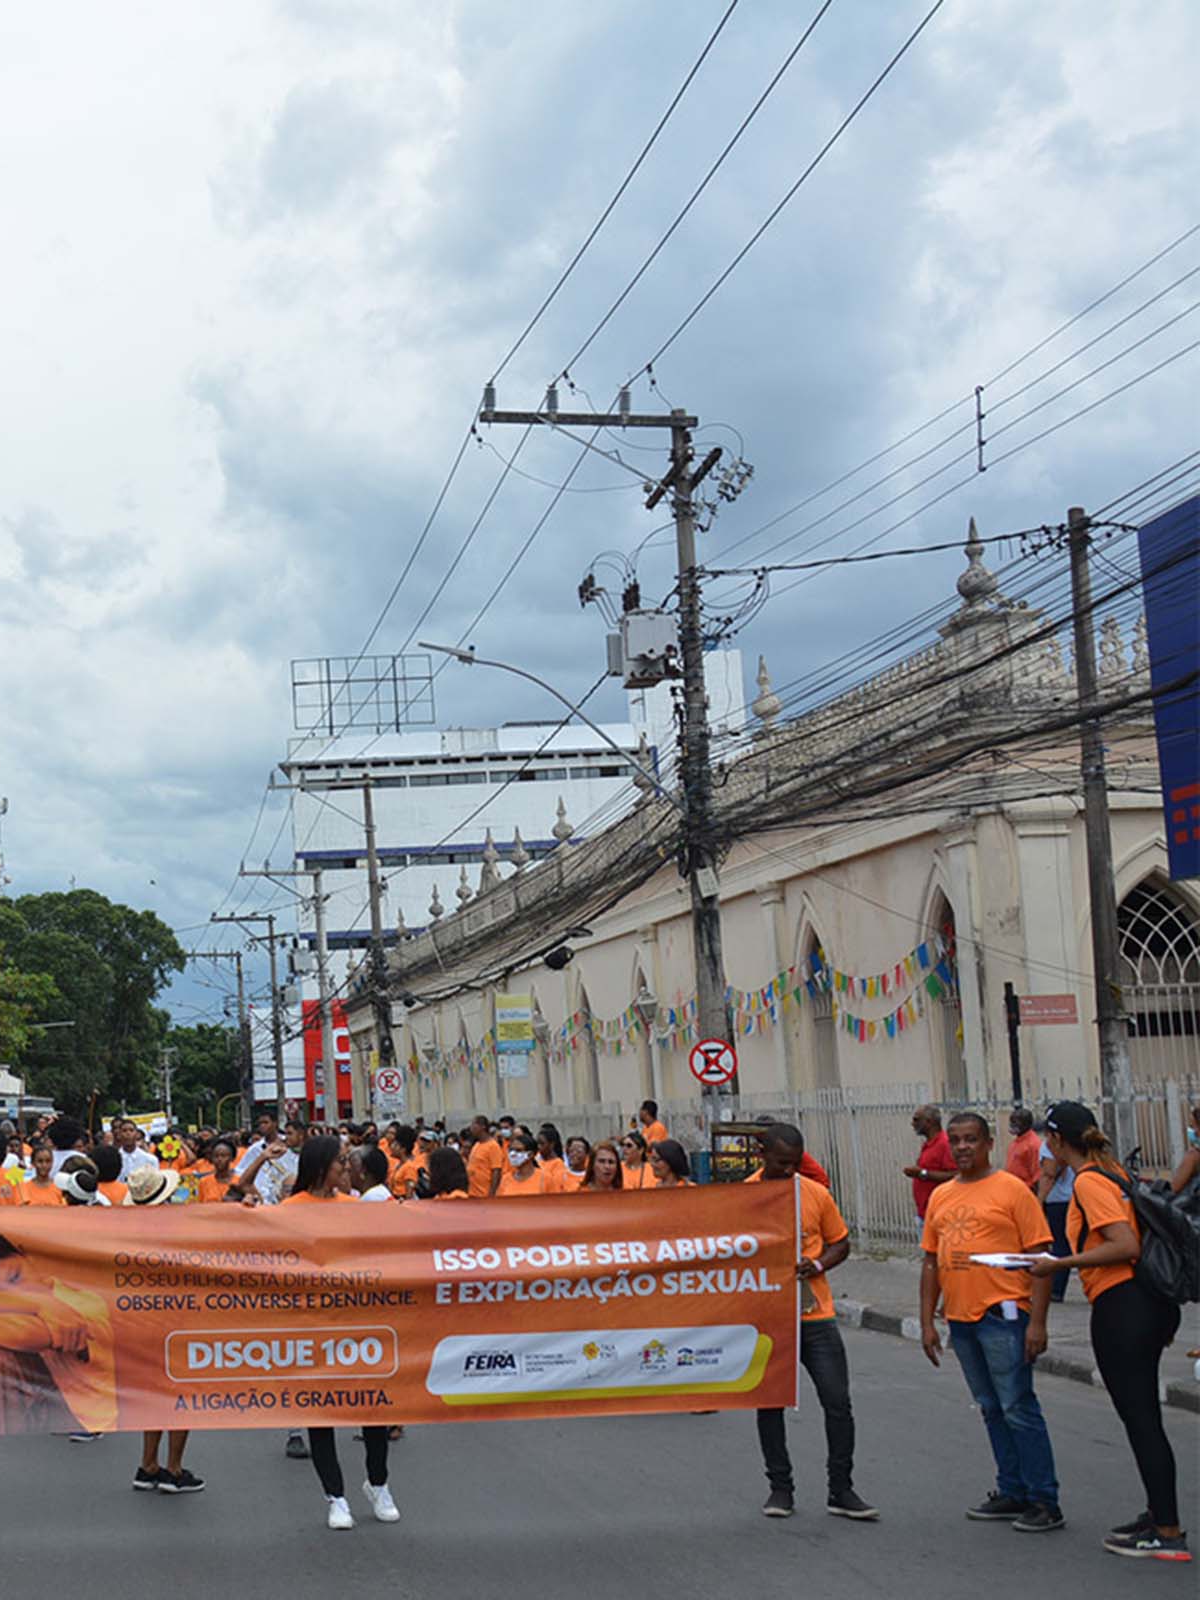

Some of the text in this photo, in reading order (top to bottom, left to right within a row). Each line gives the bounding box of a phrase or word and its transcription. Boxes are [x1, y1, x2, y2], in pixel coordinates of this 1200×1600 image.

[113, 1250, 300, 1268] O COMPORTAMENTO
[432, 1234, 760, 1272] ISSO PODE SER ABUSO
[114, 1271, 144, 1288] DO
[150, 1272, 179, 1288] SEU
[183, 1272, 235, 1287] FILHO
[283, 1269, 383, 1288] DIFERENTE?
[435, 1268, 782, 1304] E EXPLORAÇÃO SEXUAL.
[116, 1290, 417, 1311] OBSERVE, CONVERSE E DENUNCIE.
[187, 1337, 384, 1370] DISQUE 100
[464, 1353, 517, 1371] FEIRA
[175, 1388, 394, 1412] A LIGAÇÃO É GRATUITA.
